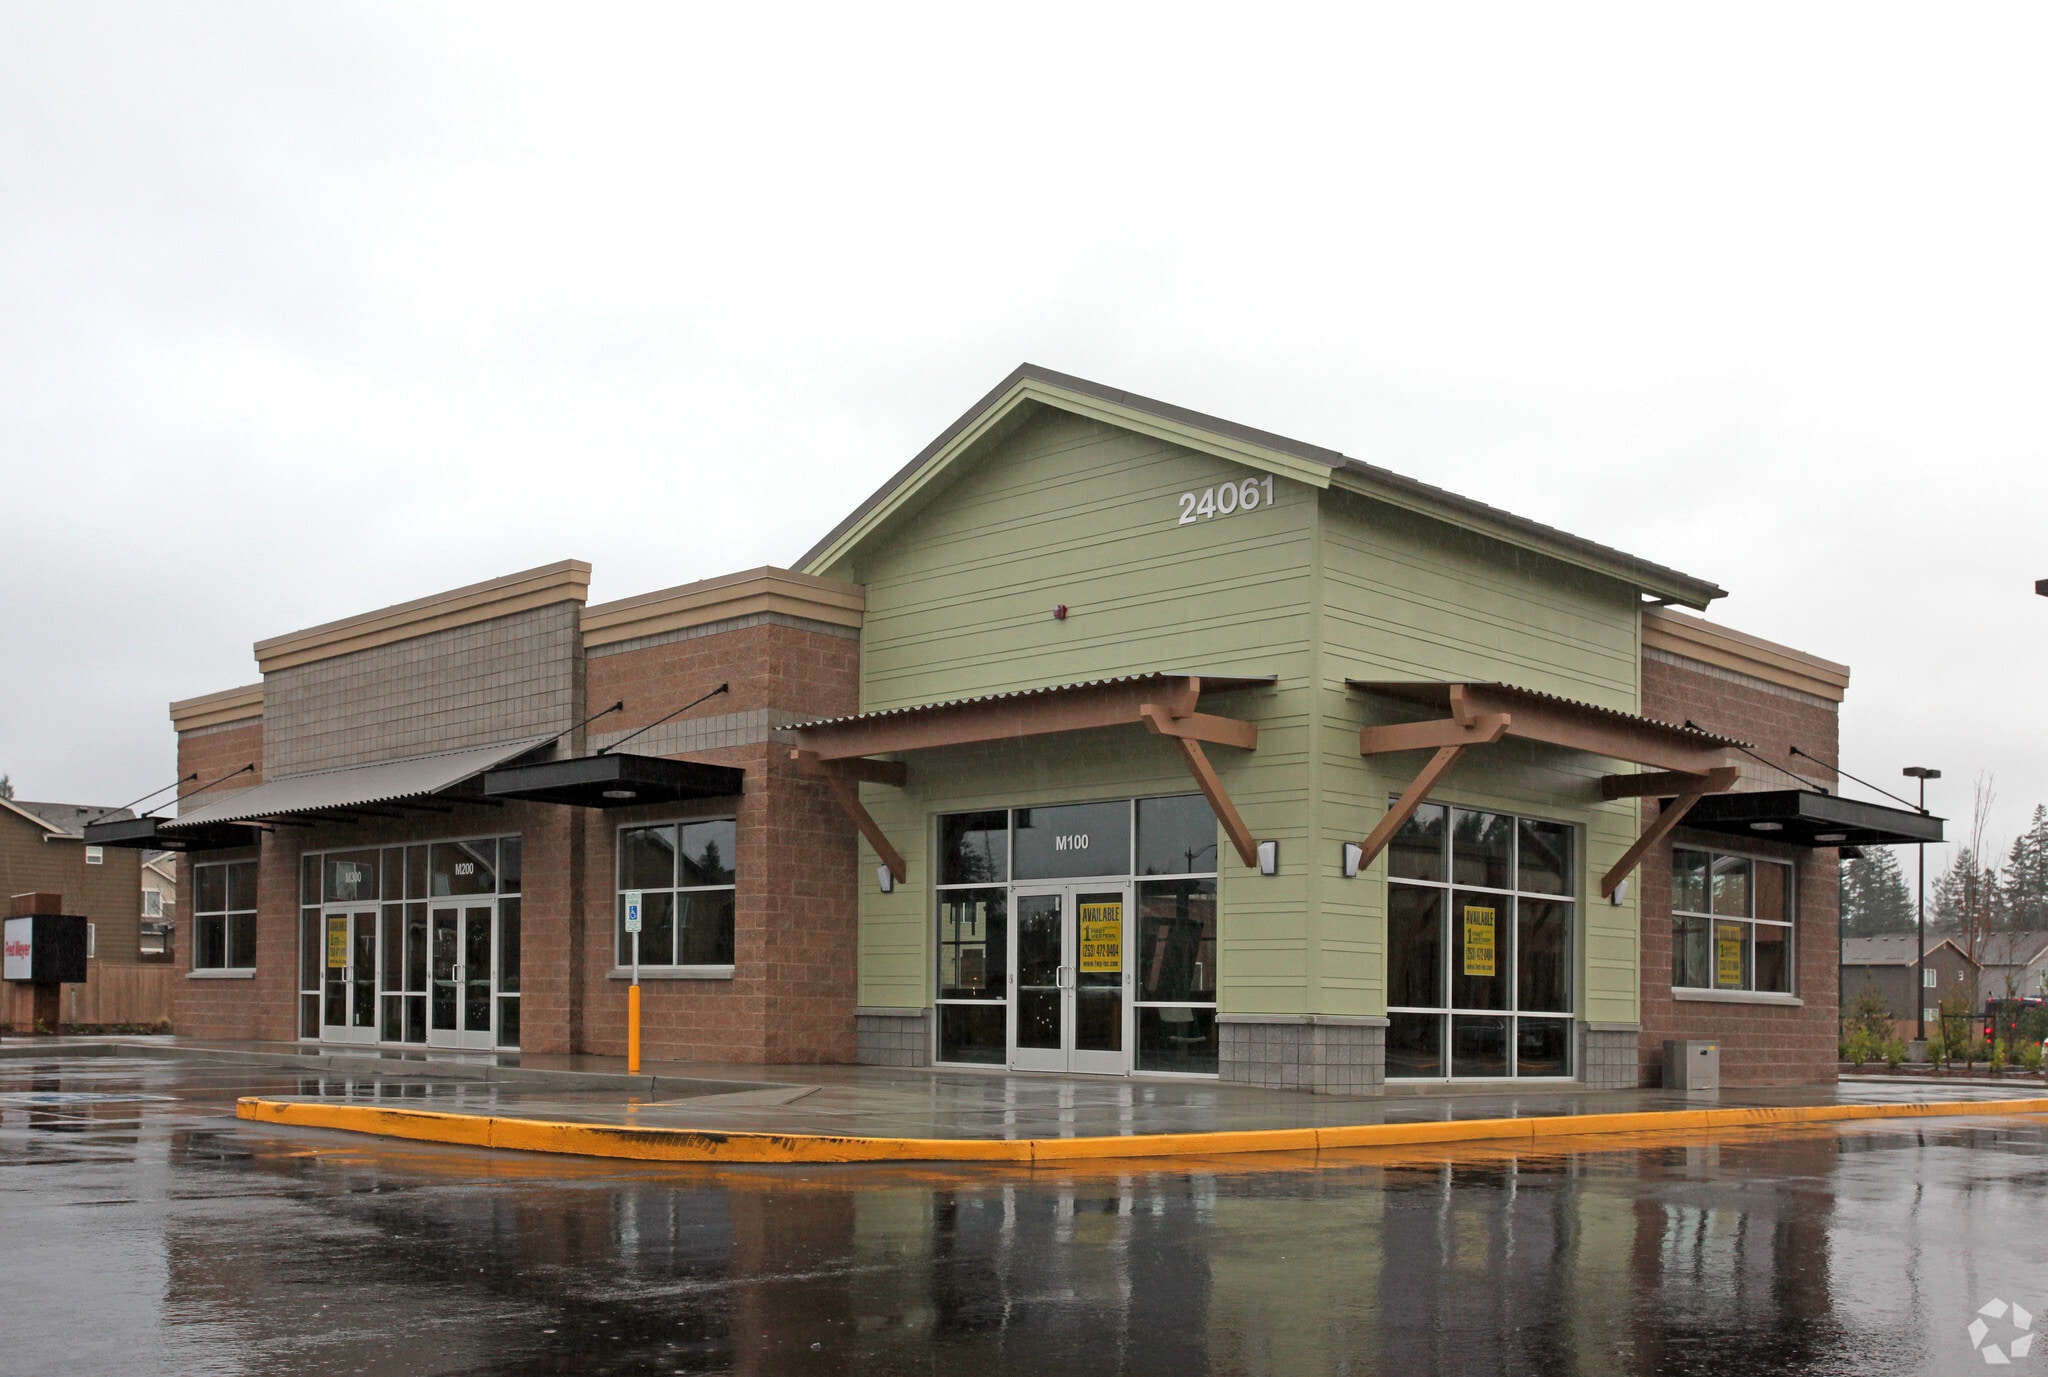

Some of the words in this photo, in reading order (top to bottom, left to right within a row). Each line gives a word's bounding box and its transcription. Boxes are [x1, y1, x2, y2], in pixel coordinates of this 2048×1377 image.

[1178, 474, 1274, 525] 24061
[1056, 834, 1089, 850] M100
[455, 863, 474, 875] M200
[345, 871, 361, 883] M300
[1082, 907, 1120, 922] AVAILABLE
[1466, 910, 1493, 926] AVAILABLE
[15, 940, 31, 960] Meyer
[1083, 943, 1095, 957] (253)
[1096, 943, 1119, 957] 472-0404
